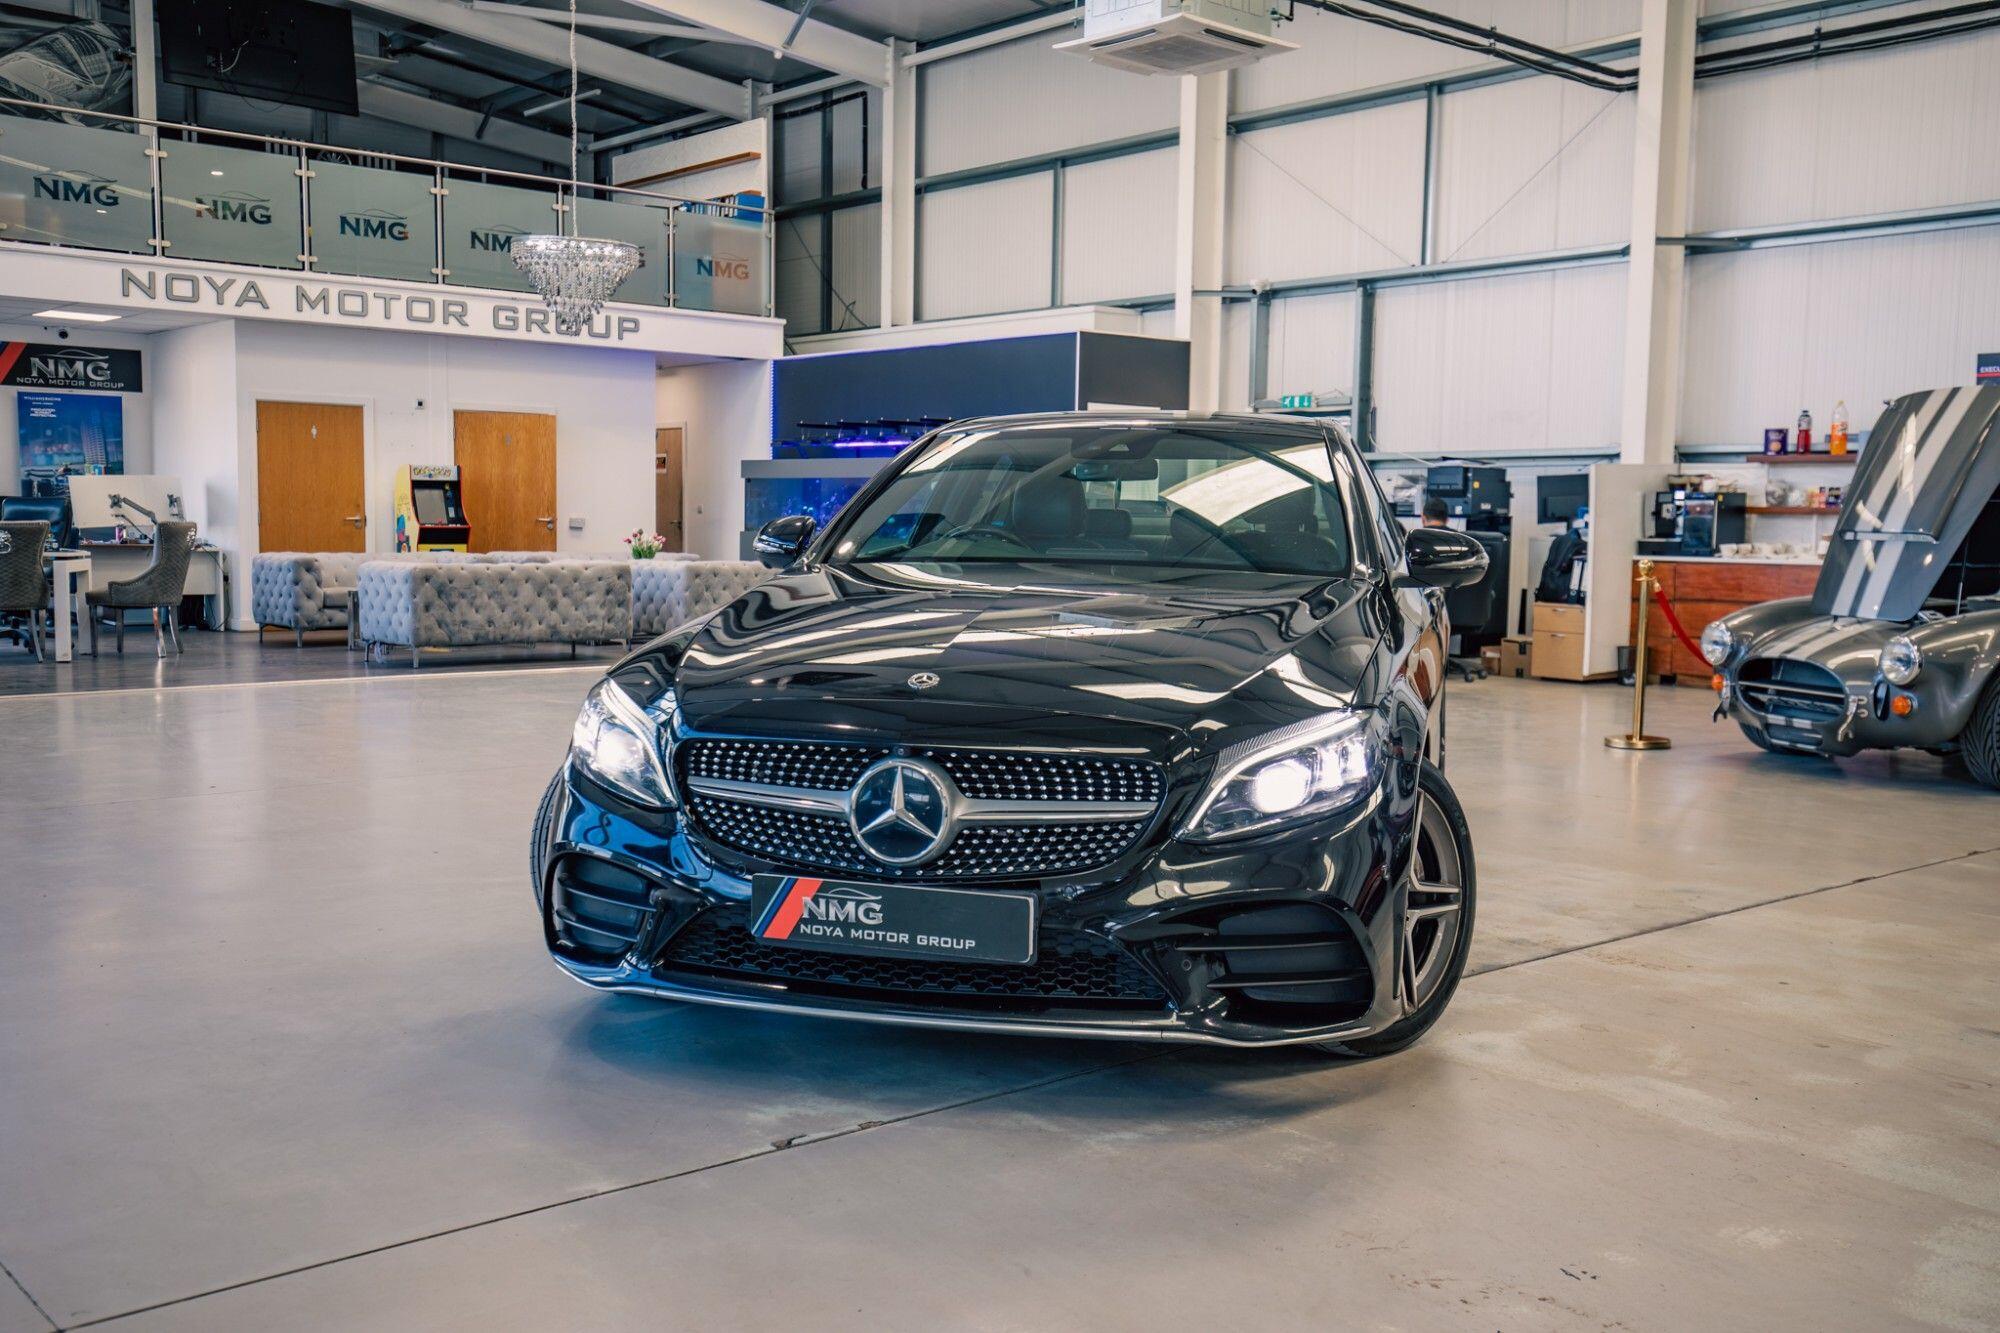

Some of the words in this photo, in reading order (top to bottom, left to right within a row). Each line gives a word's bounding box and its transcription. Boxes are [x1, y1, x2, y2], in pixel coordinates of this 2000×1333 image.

[33, 176, 119, 206] NMG
[195, 197, 272, 225] NMG
[339, 215, 409, 241] NMG
[470, 231, 512, 253] NM
[696, 258, 749, 280] NMG
[121, 268, 270, 309] NOYA
[296, 285, 469, 327] MOTOR
[30, 357, 110, 380] NMG
[16, 377, 45, 385] NOYA
[49, 379, 85, 387] MOTOR
[89, 381, 124, 389] GROUP
[802, 896, 883, 925] NMG
[800, 923, 844, 938] NOYA
[850, 928, 909, 944] MOTOR
[916, 934, 976, 950] GROUP
